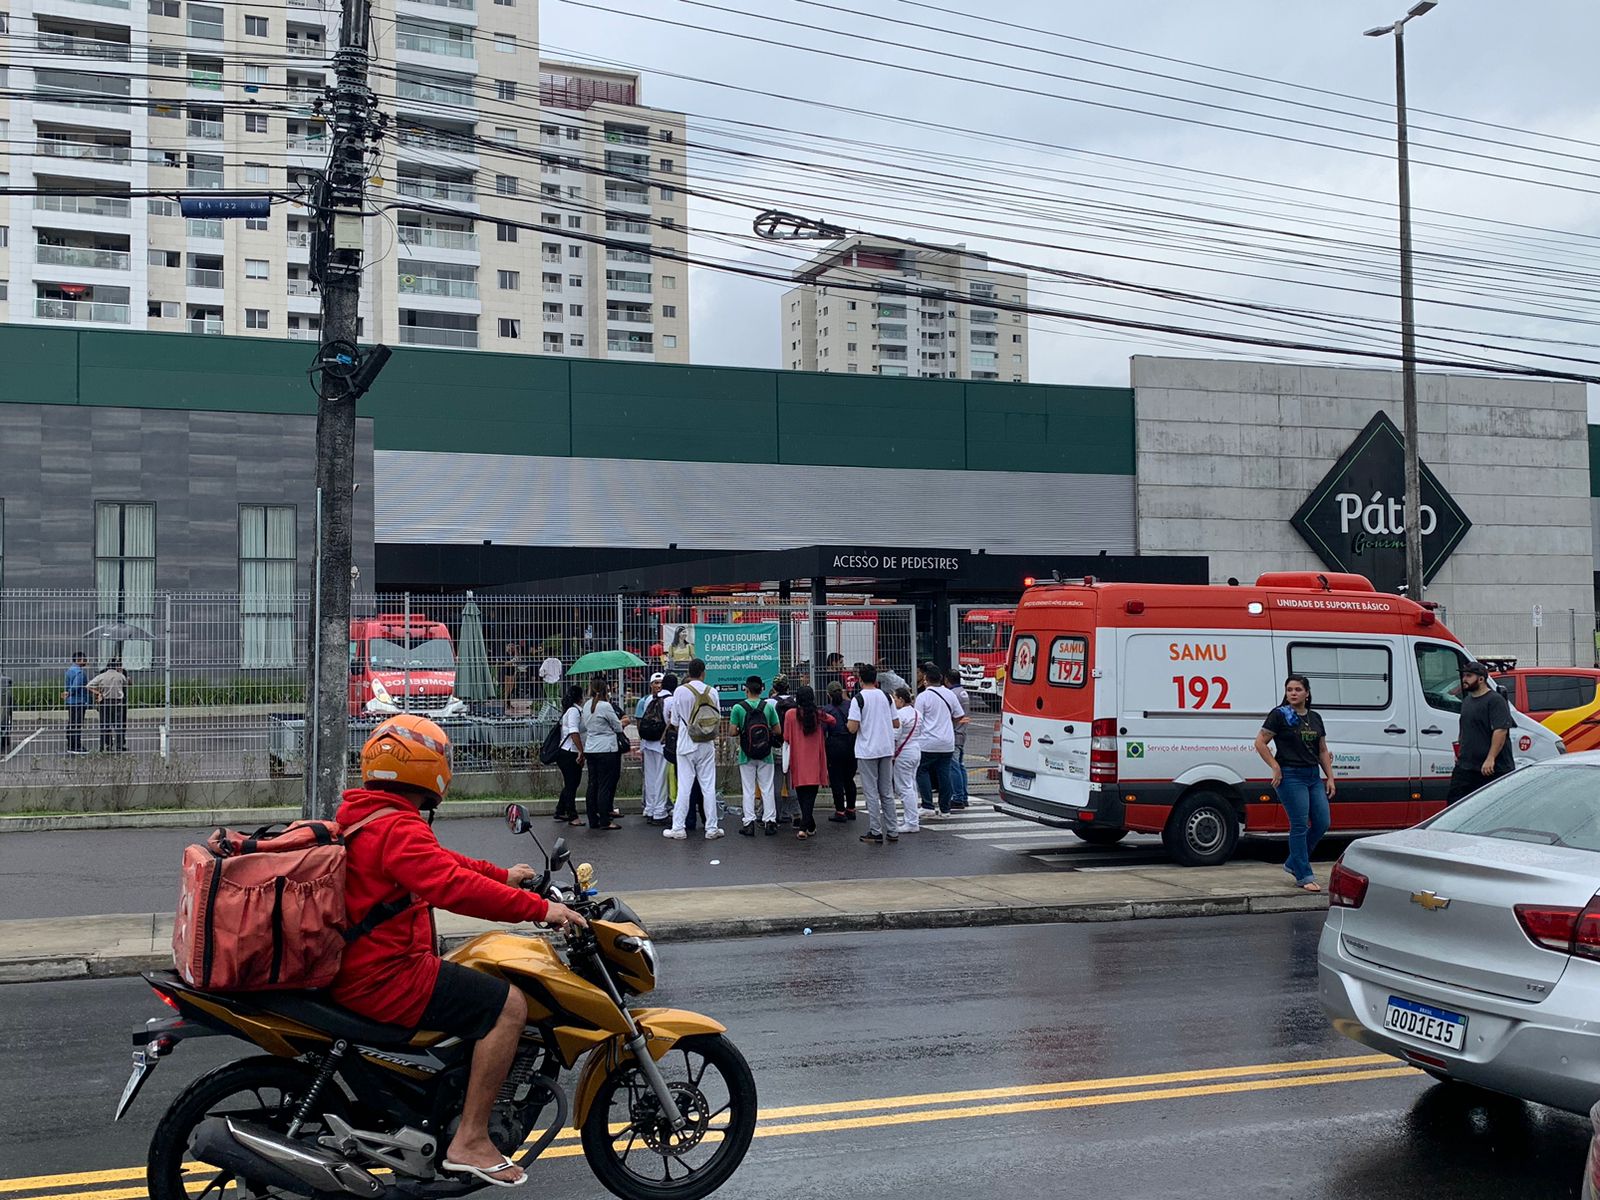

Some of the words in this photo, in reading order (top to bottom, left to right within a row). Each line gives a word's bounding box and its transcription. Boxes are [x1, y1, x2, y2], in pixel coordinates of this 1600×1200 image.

[833, 555, 879, 568] ACESSO
[883, 556, 897, 568] DE
[901, 557, 959, 570] PEDESTRES
[1276, 599, 1313, 609] UNIDADE
[1314, 600, 1324, 609] DE
[1326, 601, 1361, 610] SUPORTE
[1362, 600, 1390, 611] BÁSICO
[704, 633, 710, 642] O
[711, 632, 734, 642] PÁTIO
[735, 633, 771, 641] GOURMET
[704, 641, 710, 651] É
[711, 643, 748, 651] PARCEIRO
[1059, 642, 1084, 653] SAMU
[1169, 643, 1227, 661] SAMU
[704, 654, 730, 662] Compre
[751, 653, 773, 661] receba
[704, 662, 731, 670] dinheiro
[1058, 661, 1084, 681] 192
[1172, 675, 1231, 710] 192
[1147, 744, 1170, 752] Serviço
[1220, 744, 1239, 752] Móvel
[1335, 754, 1361, 762] Manaus
